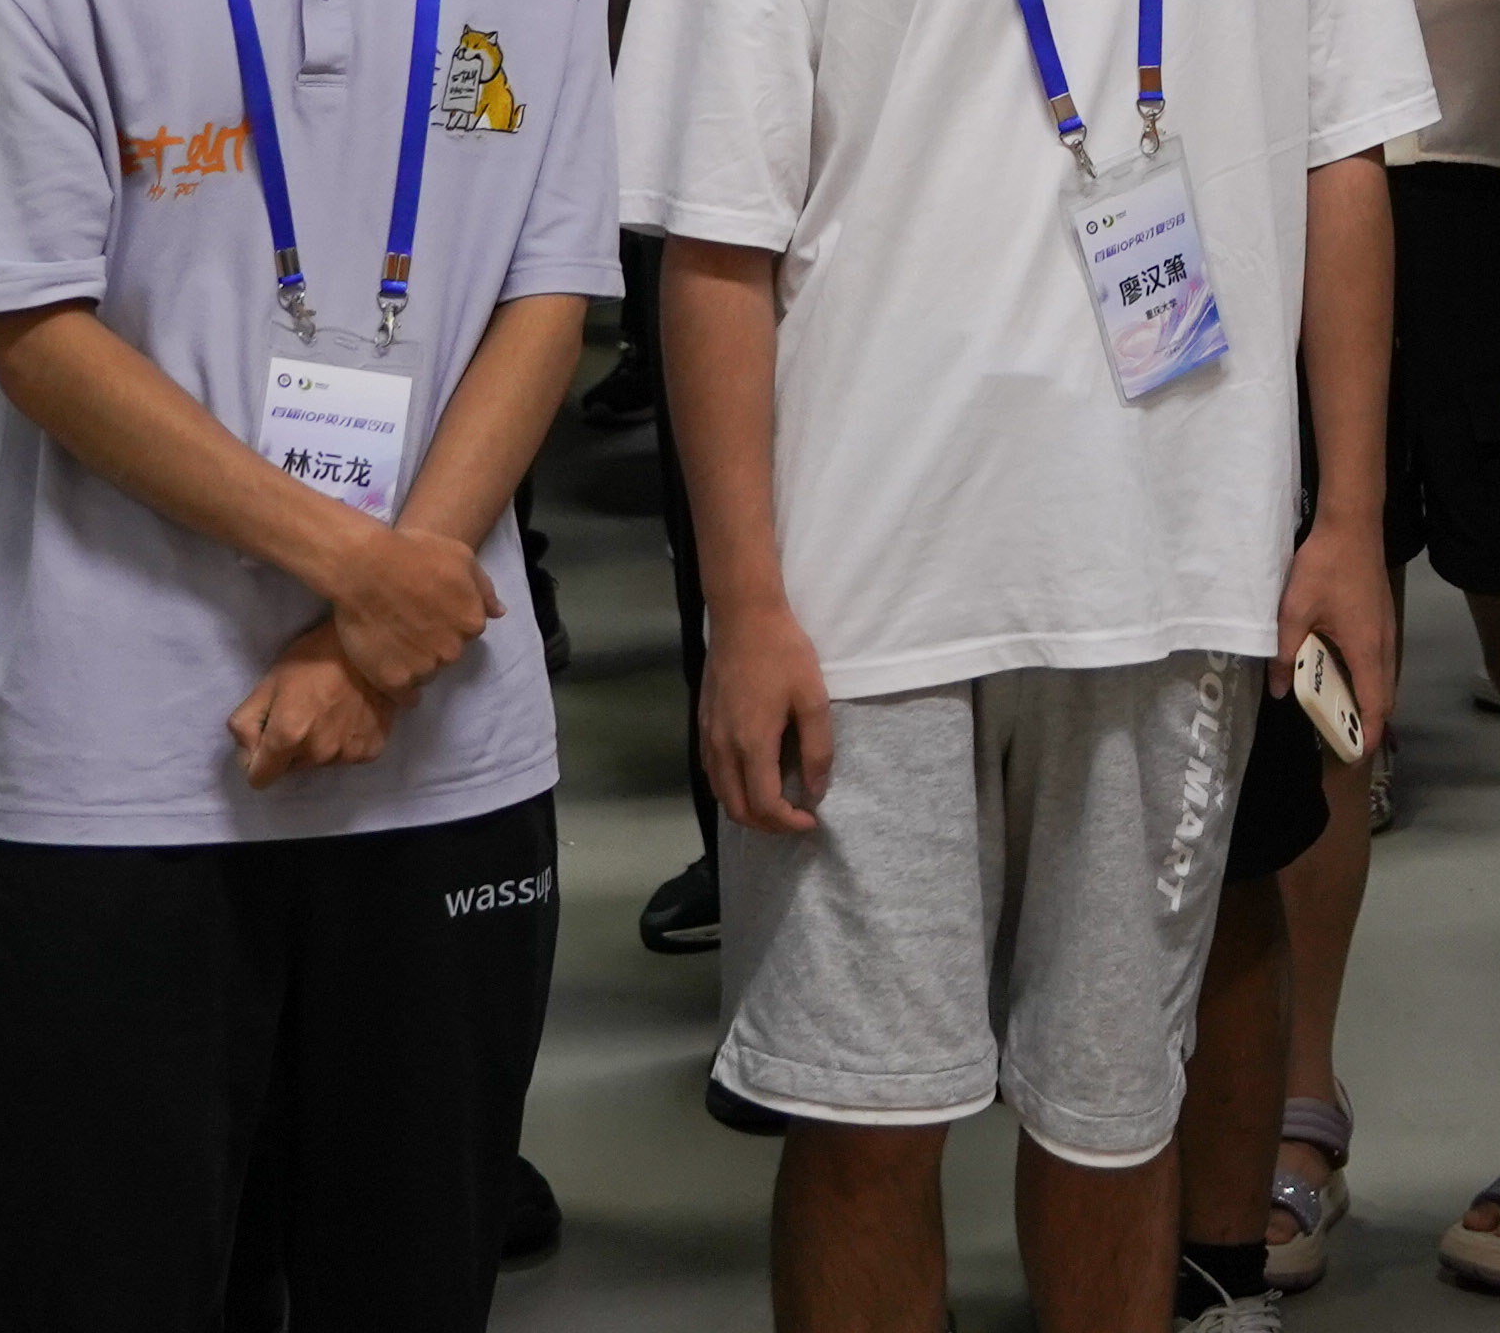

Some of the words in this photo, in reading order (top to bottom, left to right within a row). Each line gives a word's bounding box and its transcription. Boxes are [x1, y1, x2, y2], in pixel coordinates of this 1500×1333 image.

[282, 447, 373, 488] 林沅龙
[445, 866, 552, 918] wassup
